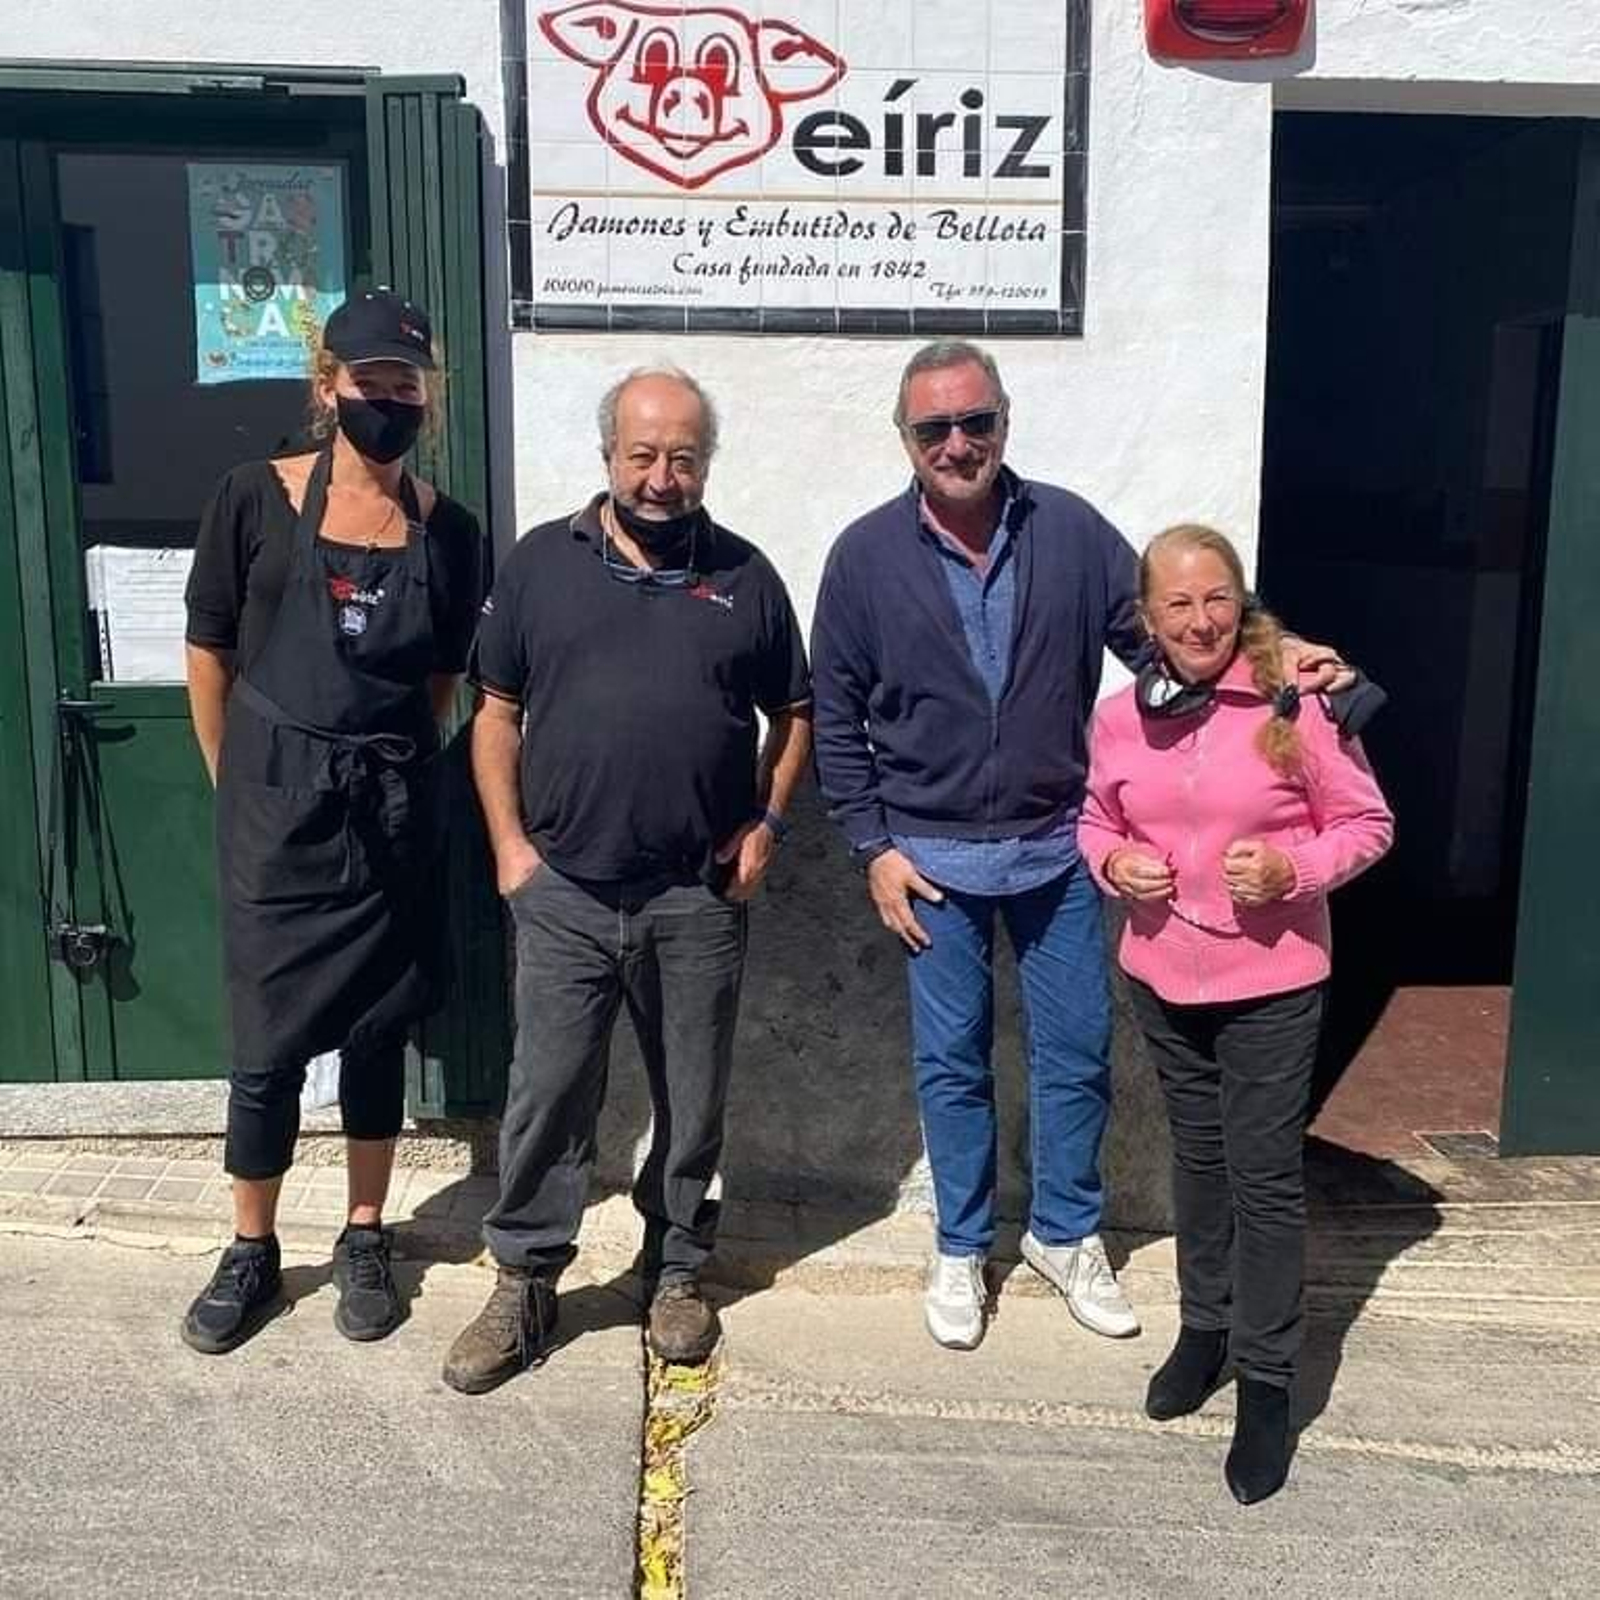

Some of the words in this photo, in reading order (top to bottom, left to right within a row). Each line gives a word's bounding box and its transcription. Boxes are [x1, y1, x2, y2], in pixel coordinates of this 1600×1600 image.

[792, 78, 1053, 178] eíriz
[547, 202, 686, 241] Jamones
[698, 219, 715, 247] y
[726, 205, 877, 241] Embutidos
[887, 211, 917, 240] de
[929, 210, 1047, 241] Bellota
[673, 252, 731, 277] Casa
[739, 254, 830, 284] fundada
[837, 262, 861, 278] en
[870, 260, 927, 279] 1842
